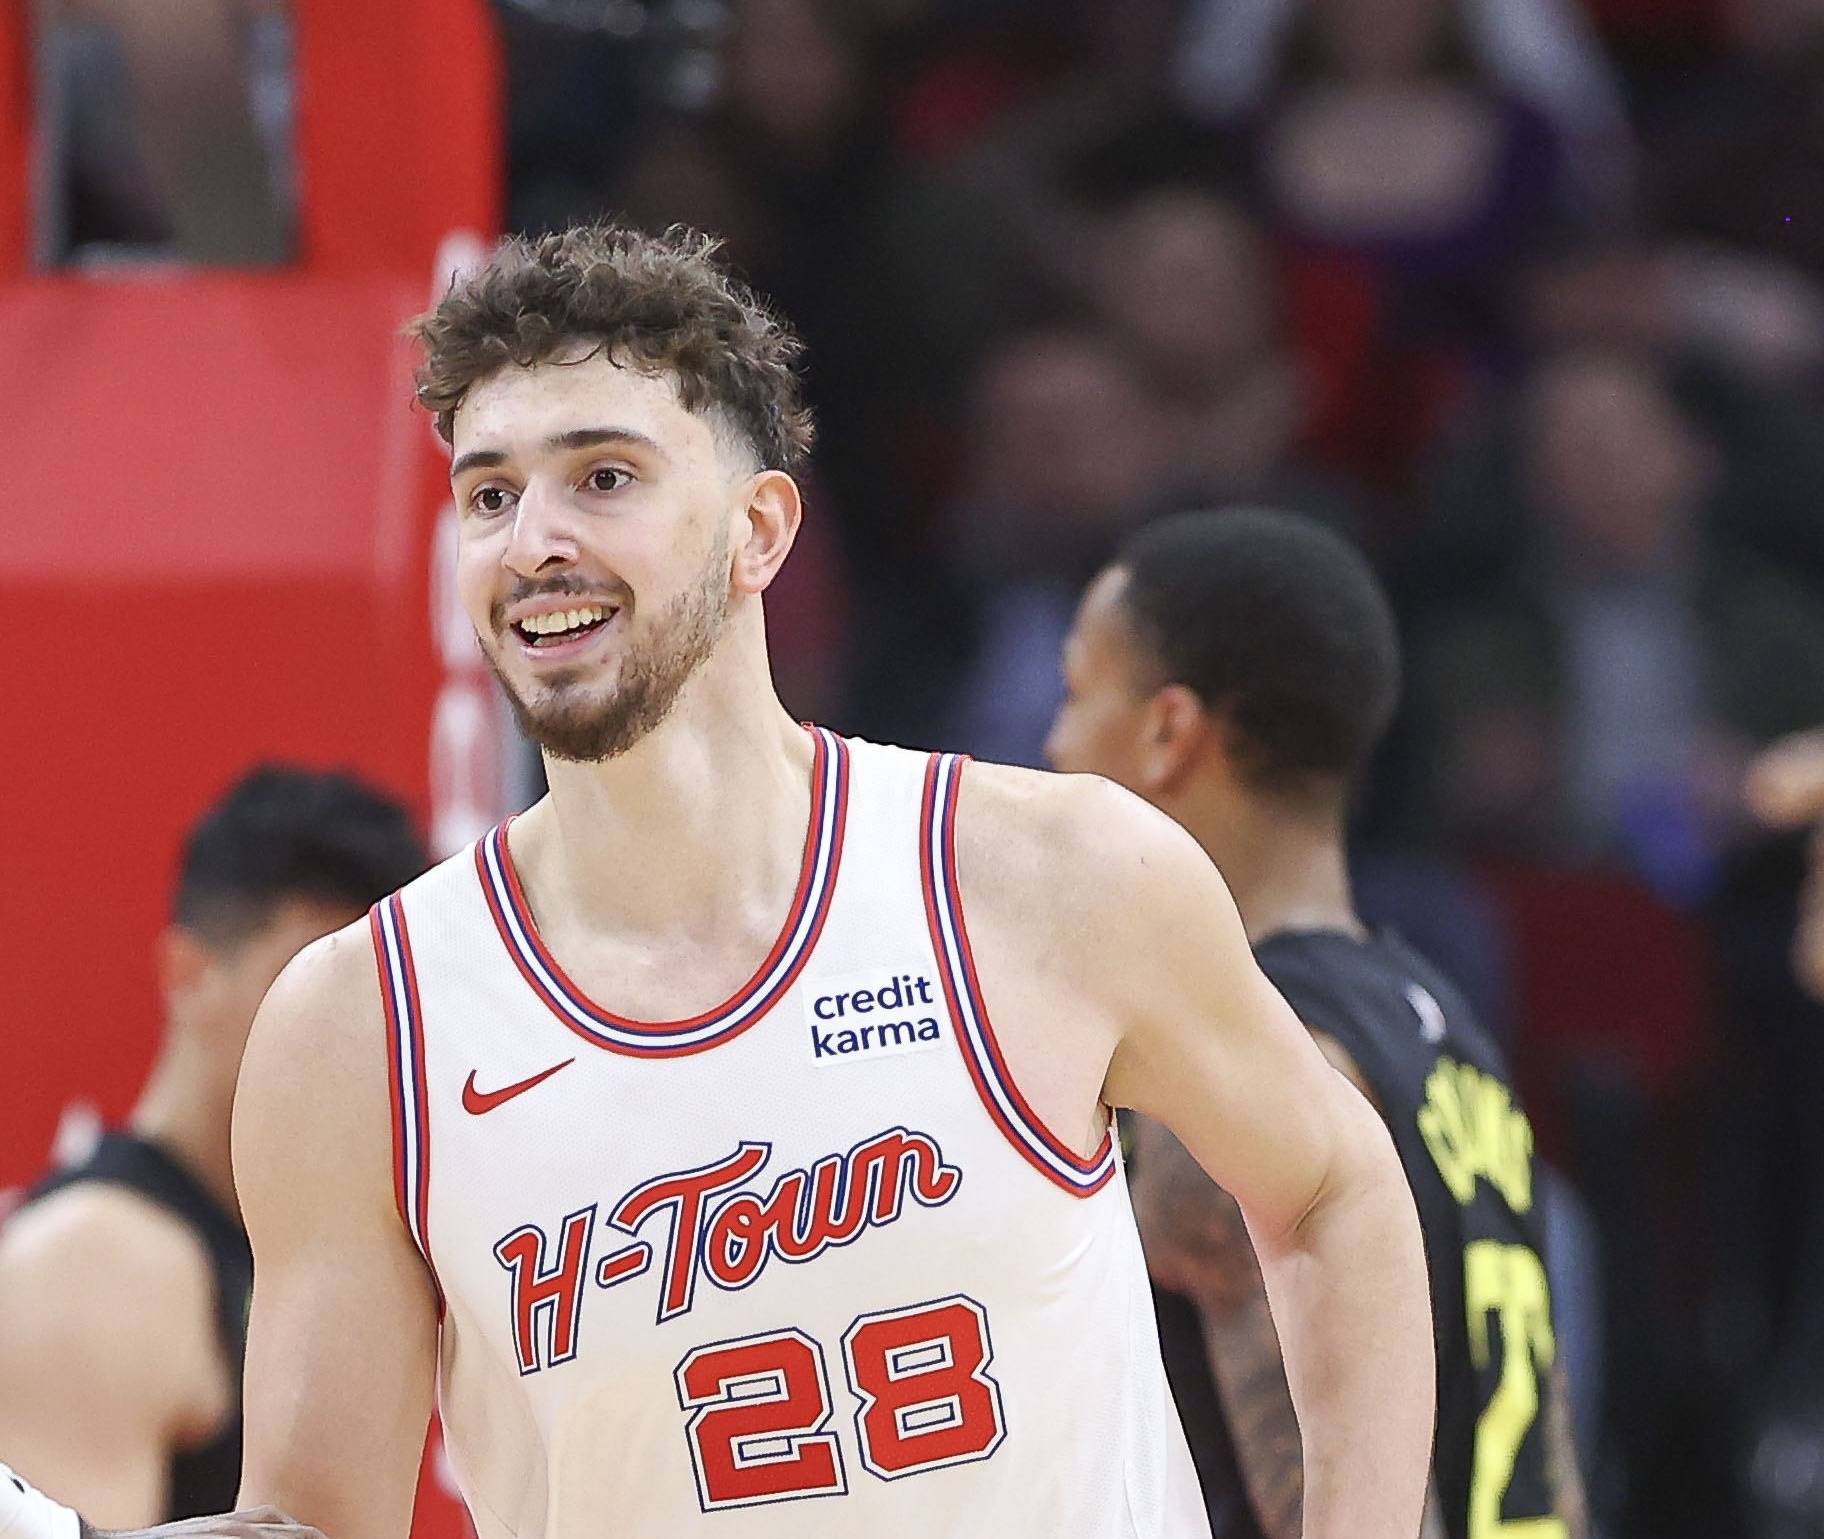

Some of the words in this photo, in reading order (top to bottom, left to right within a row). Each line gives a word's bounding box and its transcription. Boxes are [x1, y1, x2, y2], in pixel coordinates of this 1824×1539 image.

[810, 1017, 941, 1058] karma
[813, 975, 934, 1019] credit
[494, 1125, 962, 1376] H-Town
[673, 1294, 1007, 1513] 28
